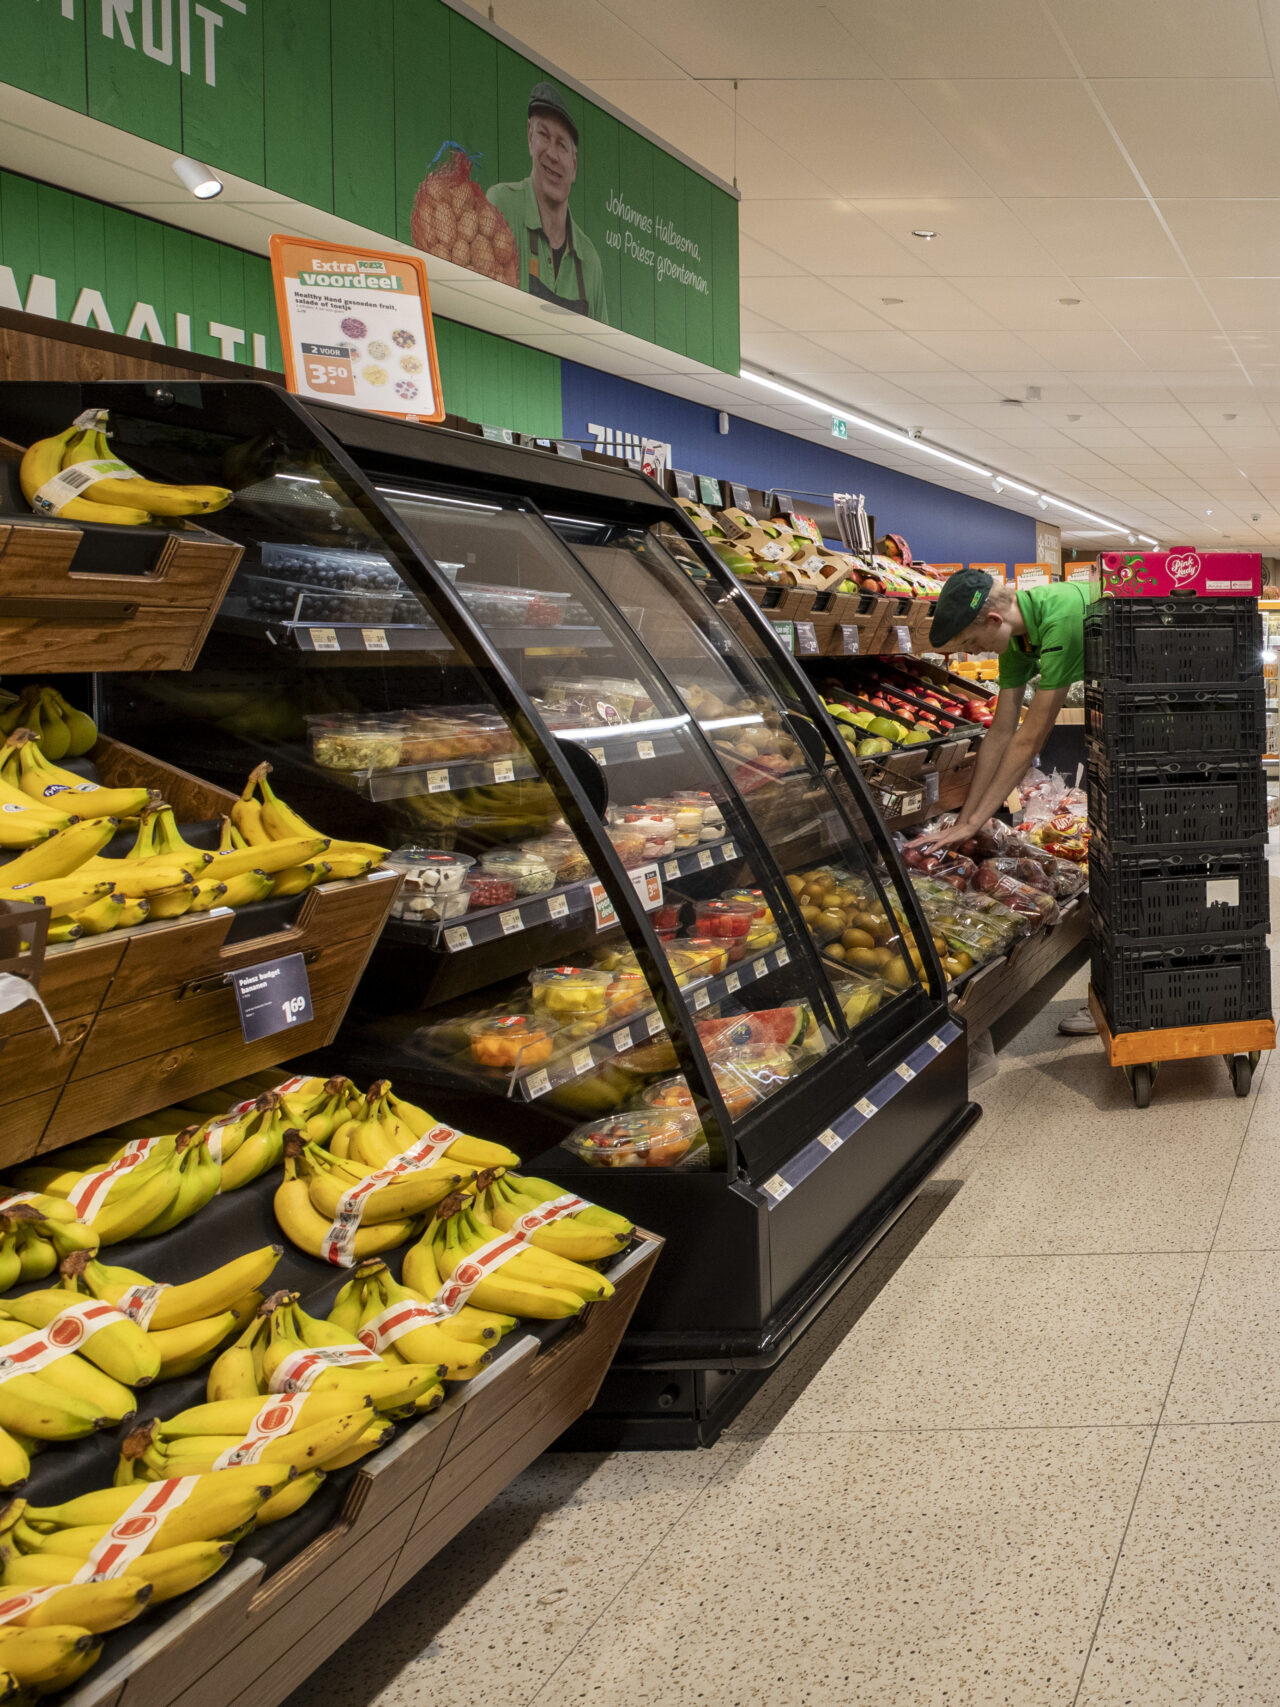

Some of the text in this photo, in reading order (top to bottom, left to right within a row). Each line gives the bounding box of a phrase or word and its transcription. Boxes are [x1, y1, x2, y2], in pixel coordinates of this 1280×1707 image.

[606, 188, 653, 234] Johannes
[606, 230, 622, 250] uw
[625, 230, 655, 266] Poiesz
[312, 259, 356, 272] Extra
[303, 273, 397, 289] voordeel
[311, 346, 341, 356] 2 VOOR
[1171, 556, 1194, 572] Pink
[1174, 566, 1197, 579] Lady
[259, 968, 281, 981] budget
[240, 981, 268, 994] bananen
